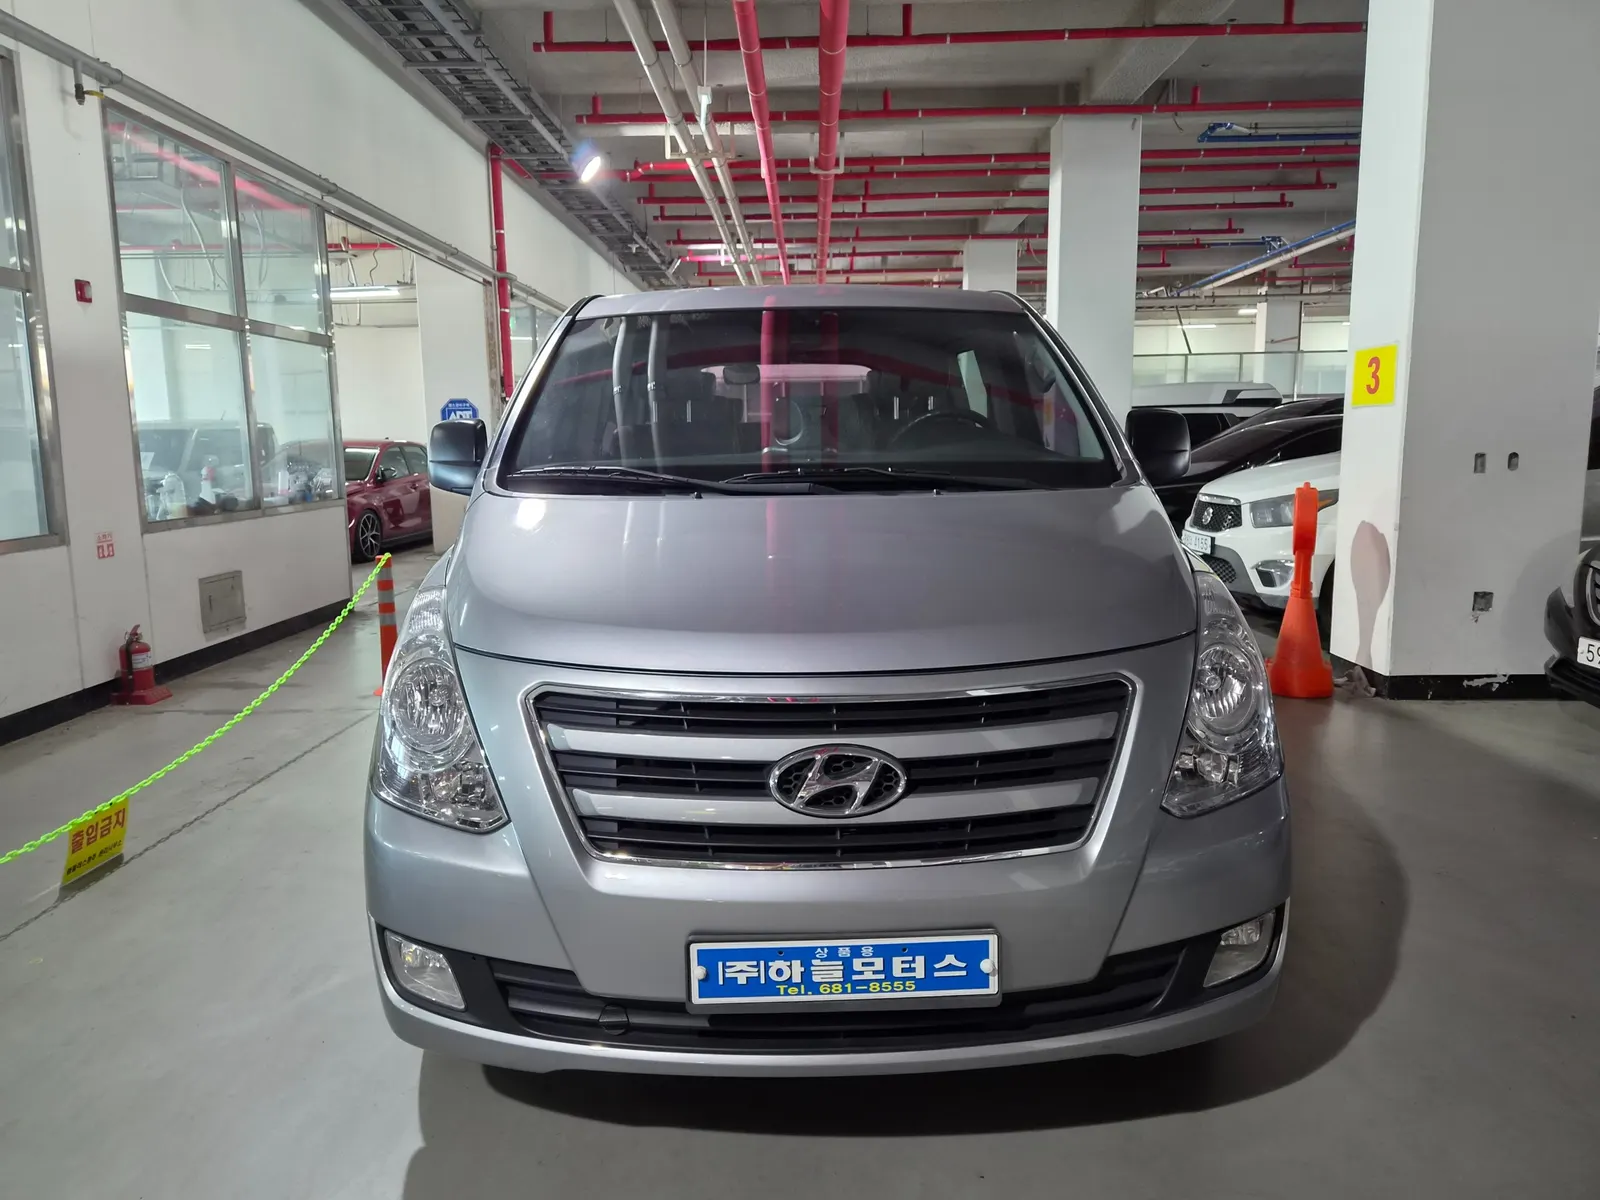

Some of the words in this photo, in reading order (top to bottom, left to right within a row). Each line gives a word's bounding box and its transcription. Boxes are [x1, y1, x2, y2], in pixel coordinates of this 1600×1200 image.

[1366, 356, 1381, 395] 3
[449, 410, 472, 420] ADT
[71, 808, 126, 855] 출입금지
[815, 946, 873, 958] 상품용
[776, 985, 812, 995] Tel.
[819, 981, 916, 994] 681-8555
